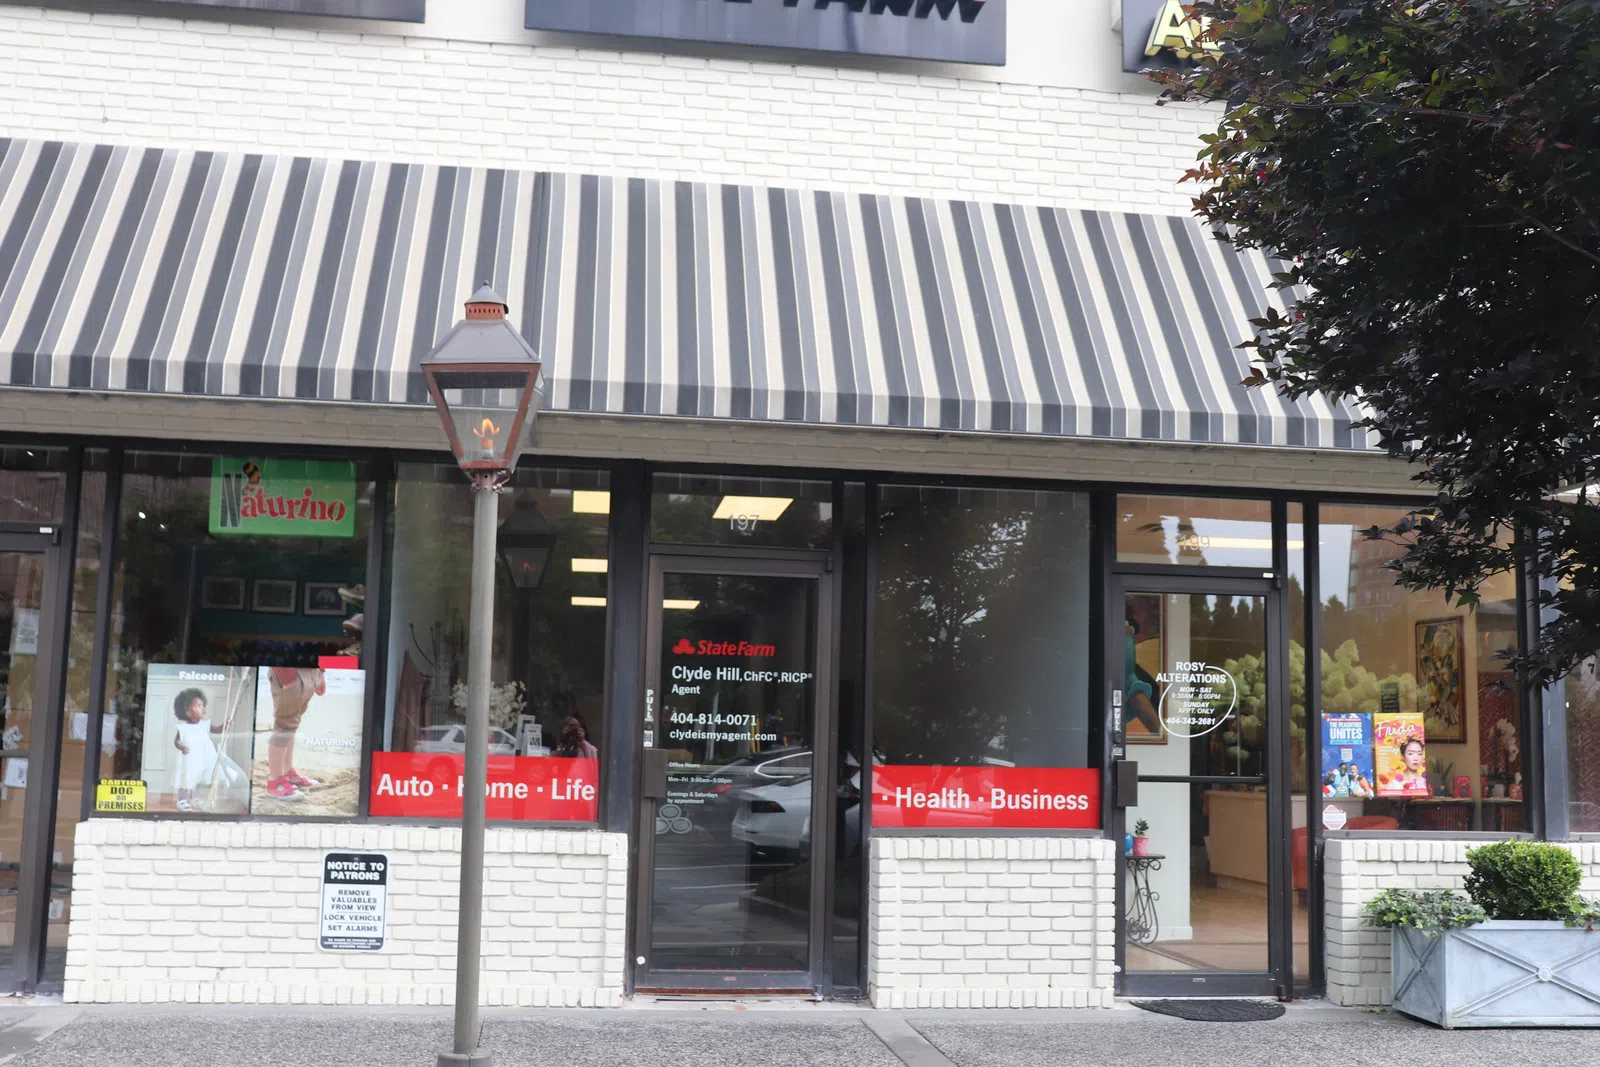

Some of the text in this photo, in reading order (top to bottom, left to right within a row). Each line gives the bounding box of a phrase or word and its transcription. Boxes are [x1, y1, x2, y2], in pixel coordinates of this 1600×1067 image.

[219, 471, 346, 528] Naturino
[727, 514, 760, 531] 197
[1179, 534, 1210, 551] 199
[1175, 661, 1206, 672] ROSY
[178, 670, 226, 682] Falcotto
[671, 665, 712, 682] Clyde
[1155, 672, 1227, 684] ALTERATIONS
[671, 683, 701, 696] Agent
[670, 712, 757, 726] 404-814-0071
[1329, 727, 1363, 740] UNITES
[1376, 719, 1416, 738] Frida
[306, 736, 356, 747] NATURINO
[669, 729, 777, 742] clydeismyagent.com
[111, 787, 133, 795] DOG
[376, 773, 434, 797] Auto
[551, 777, 595, 801] Life
[895, 786, 1089, 811] Health Business
[98, 801, 144, 810] PREMISES
[327, 861, 385, 872] NOTICE TO
[330, 871, 380, 881] PATRONS
[331, 896, 377, 904] VALUABLES
